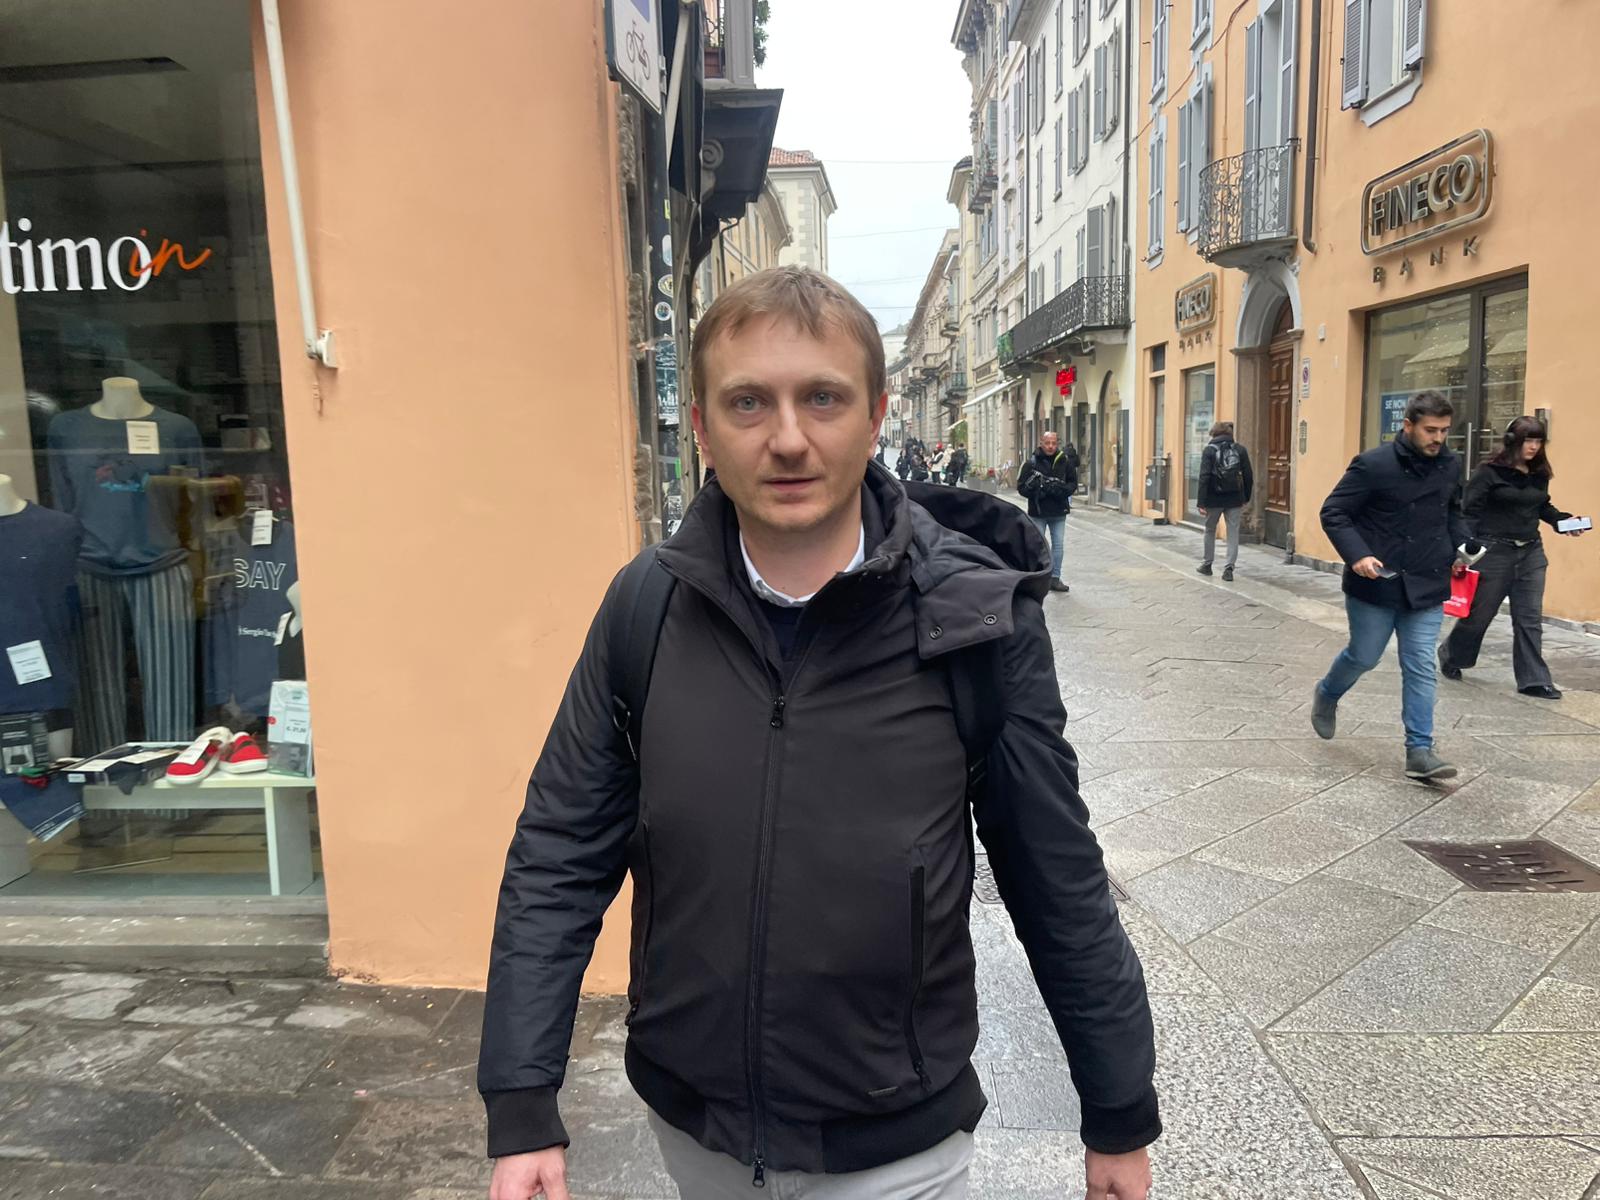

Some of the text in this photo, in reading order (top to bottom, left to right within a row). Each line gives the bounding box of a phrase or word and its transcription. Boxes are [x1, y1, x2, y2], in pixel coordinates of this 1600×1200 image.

[1371, 154, 1476, 236] FINECO
[1373, 235, 1479, 284] BANK
[1177, 284, 1212, 321] FINECO
